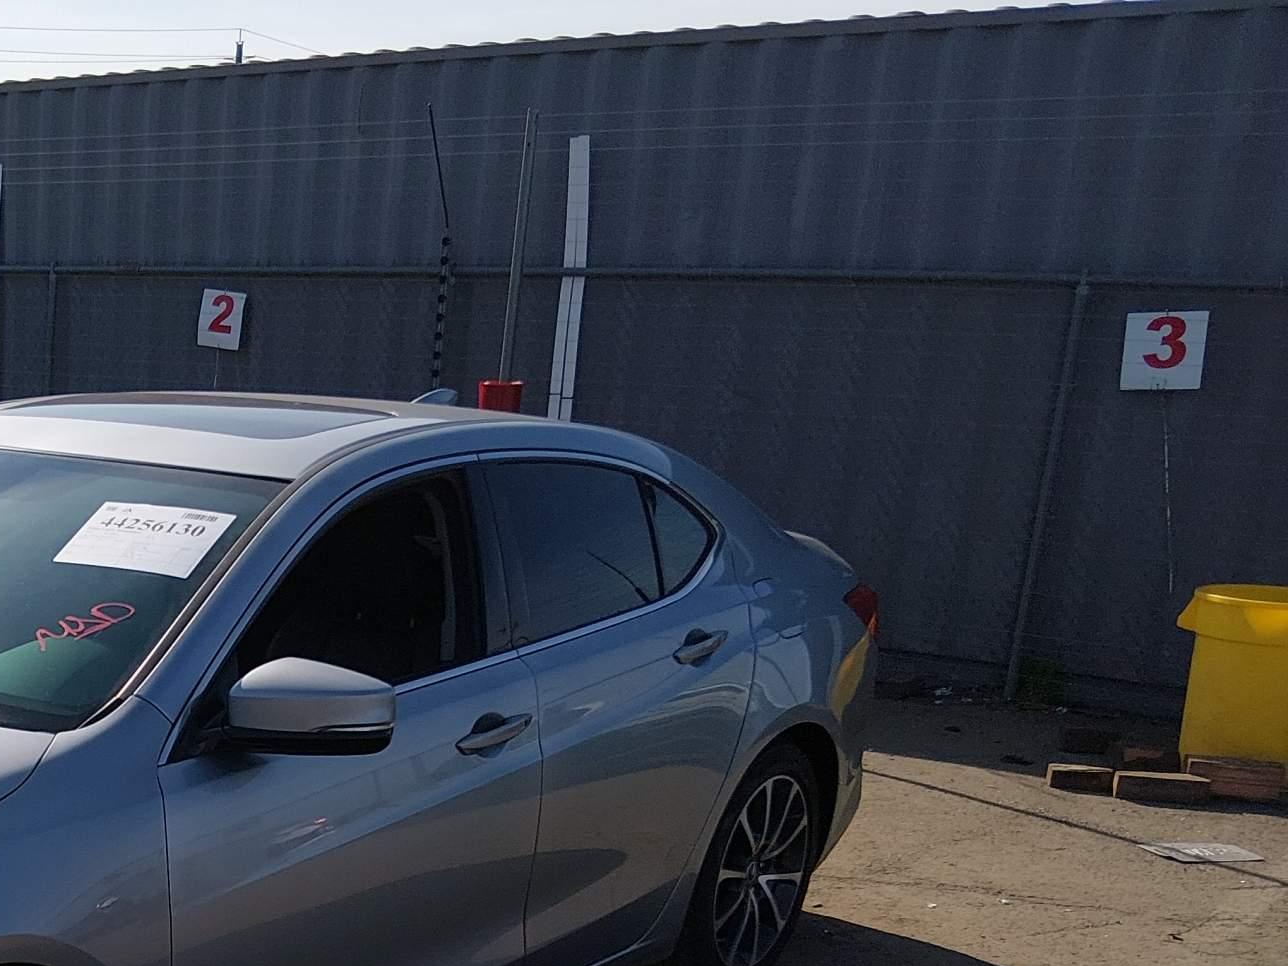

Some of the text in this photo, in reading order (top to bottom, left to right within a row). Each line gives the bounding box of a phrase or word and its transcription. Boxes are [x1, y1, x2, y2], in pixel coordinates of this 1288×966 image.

[208, 295, 234, 334] 2
[1143, 316, 1186, 369] 3
[101, 515, 206, 537] 44256130
